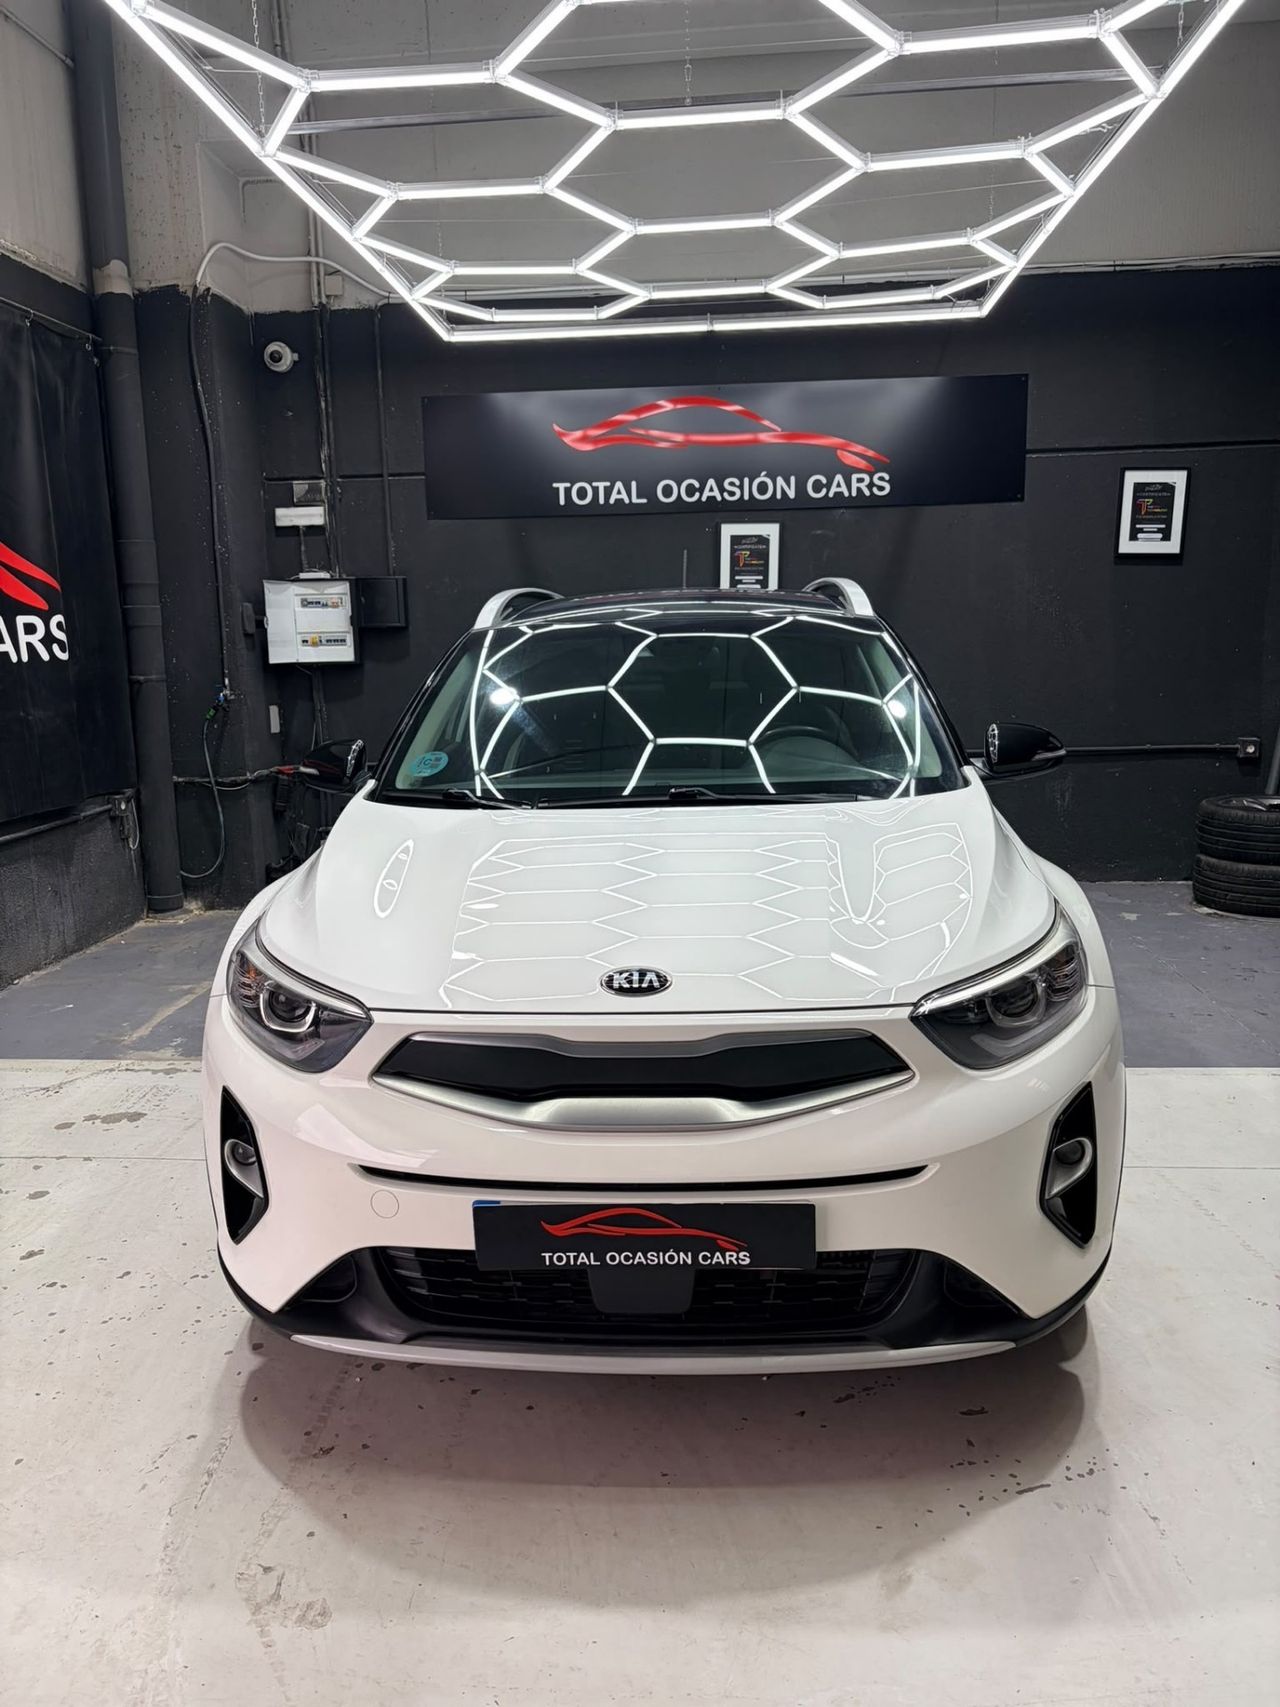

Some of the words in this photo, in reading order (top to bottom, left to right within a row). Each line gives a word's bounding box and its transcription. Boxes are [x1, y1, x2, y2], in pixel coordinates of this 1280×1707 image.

[552, 480, 648, 506] TOTAL
[656, 471, 796, 503] OCASIÓN
[806, 472, 891, 499] CARS
[612, 971, 660, 988] KIA
[541, 1252, 601, 1266] TOTAL
[605, 1249, 692, 1265] OCASIÓN
[698, 1251, 751, 1265] CARS
